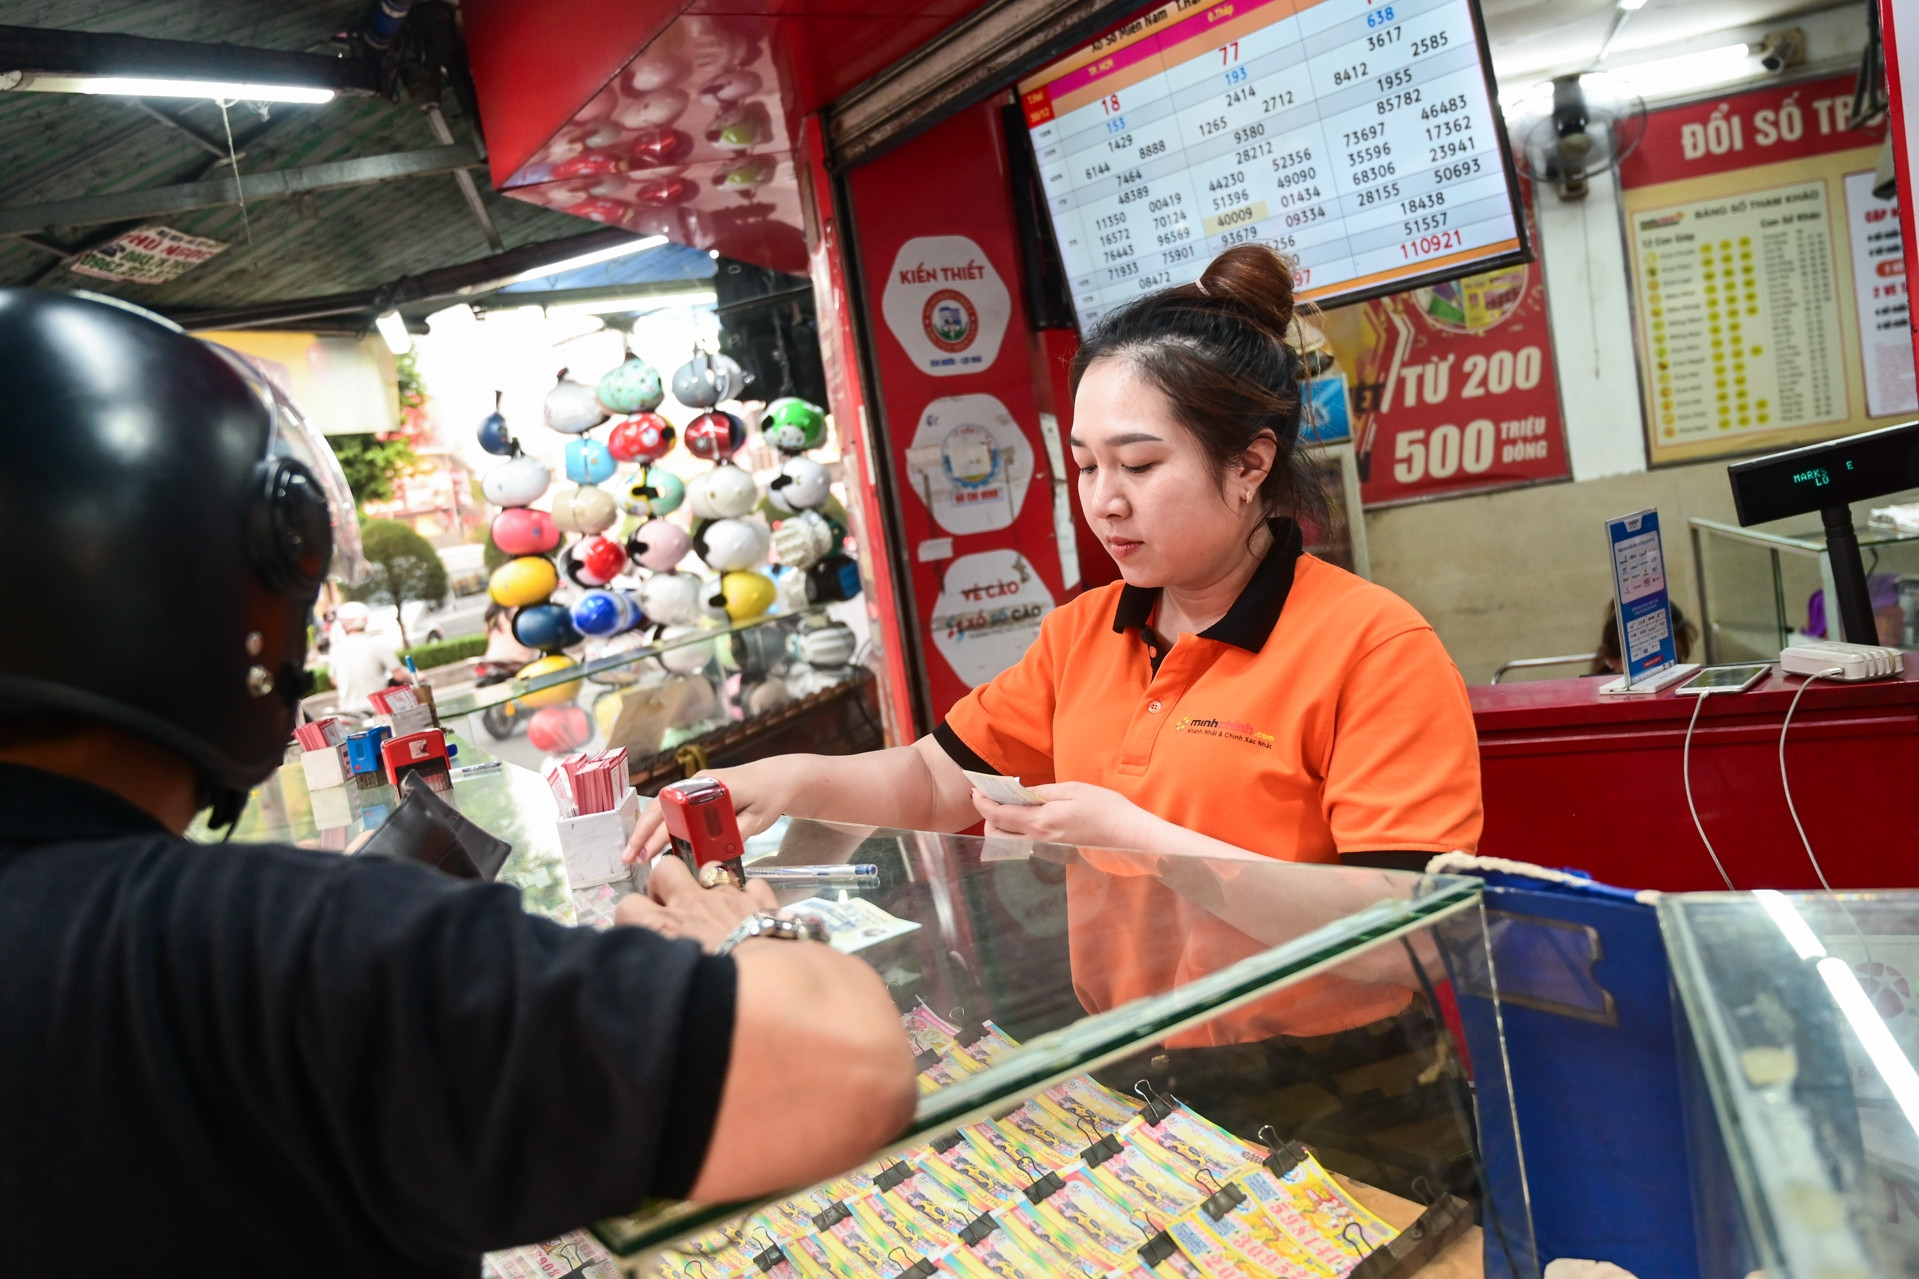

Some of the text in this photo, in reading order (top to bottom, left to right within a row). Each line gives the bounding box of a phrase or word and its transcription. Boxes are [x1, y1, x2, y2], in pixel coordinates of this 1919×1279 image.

[1367, 6, 1395, 28] 638
[1367, 26, 1402, 52] 3617
[1411, 31, 1449, 57] 2585
[1219, 41, 1239, 66] 77
[1225, 67, 1248, 86] 193
[1334, 62, 1369, 86] 8412
[1377, 68, 1413, 92] 1955
[1101, 94, 1121, 116] 18
[1225, 85, 1256, 107] 2414
[1263, 91, 1294, 113] 2712
[1377, 88, 1422, 115] 85782
[1421, 94, 1467, 121] 46483
[1106, 117, 1127, 135] 153
[1199, 116, 1228, 137] 1265
[1234, 123, 1266, 144] 9380
[1343, 122, 1386, 148] 73697
[1425, 115, 1472, 142] 17362
[1681, 103, 1744, 160] ĐỔI
[1754, 91, 1804, 146] SỐ
[1107, 134, 1134, 154] 1429
[1139, 140, 1166, 160] 8888
[1236, 141, 1274, 165] 28212
[1348, 142, 1391, 167] 35596
[1429, 136, 1476, 163] 23941
[1272, 147, 1312, 172] 52356
[1085, 162, 1111, 180] 6144
[1116, 169, 1143, 188] 7464
[1209, 171, 1246, 192] 44230
[1277, 167, 1317, 189] 49090
[1352, 162, 1396, 186] 68306
[1434, 158, 1481, 184] 50693
[1118, 185, 1150, 205] 48389
[1149, 192, 1182, 213] 00419
[1213, 188, 1249, 211] 51396
[1281, 185, 1321, 208] 01434
[1357, 182, 1401, 207] 28155
[1400, 192, 1446, 215] 18438
[1096, 212, 1127, 232] 11350
[1153, 209, 1187, 230] 70124
[1217, 207, 1254, 228] 40009
[1285, 206, 1326, 228] 09334
[1404, 212, 1449, 236] 51557
[1100, 228, 1131, 248] 16572
[1157, 227, 1191, 247] 96569
[1221, 226, 1258, 246] 93679
[1400, 229, 1463, 260] 110921
[1103, 244, 1135, 264] 76443
[1162, 245, 1195, 265] 75901
[899, 259, 986, 285] KIẾN THIẾT
[1108, 261, 1140, 281] 71933
[1139, 271, 1171, 290] 08472
[1400, 353, 1456, 408] TỪ
[1461, 345, 1543, 399] 200
[1393, 418, 1496, 484] 500
[1500, 415, 1547, 441] TRIỆU
[1502, 440, 1548, 464] ĐỒNG
